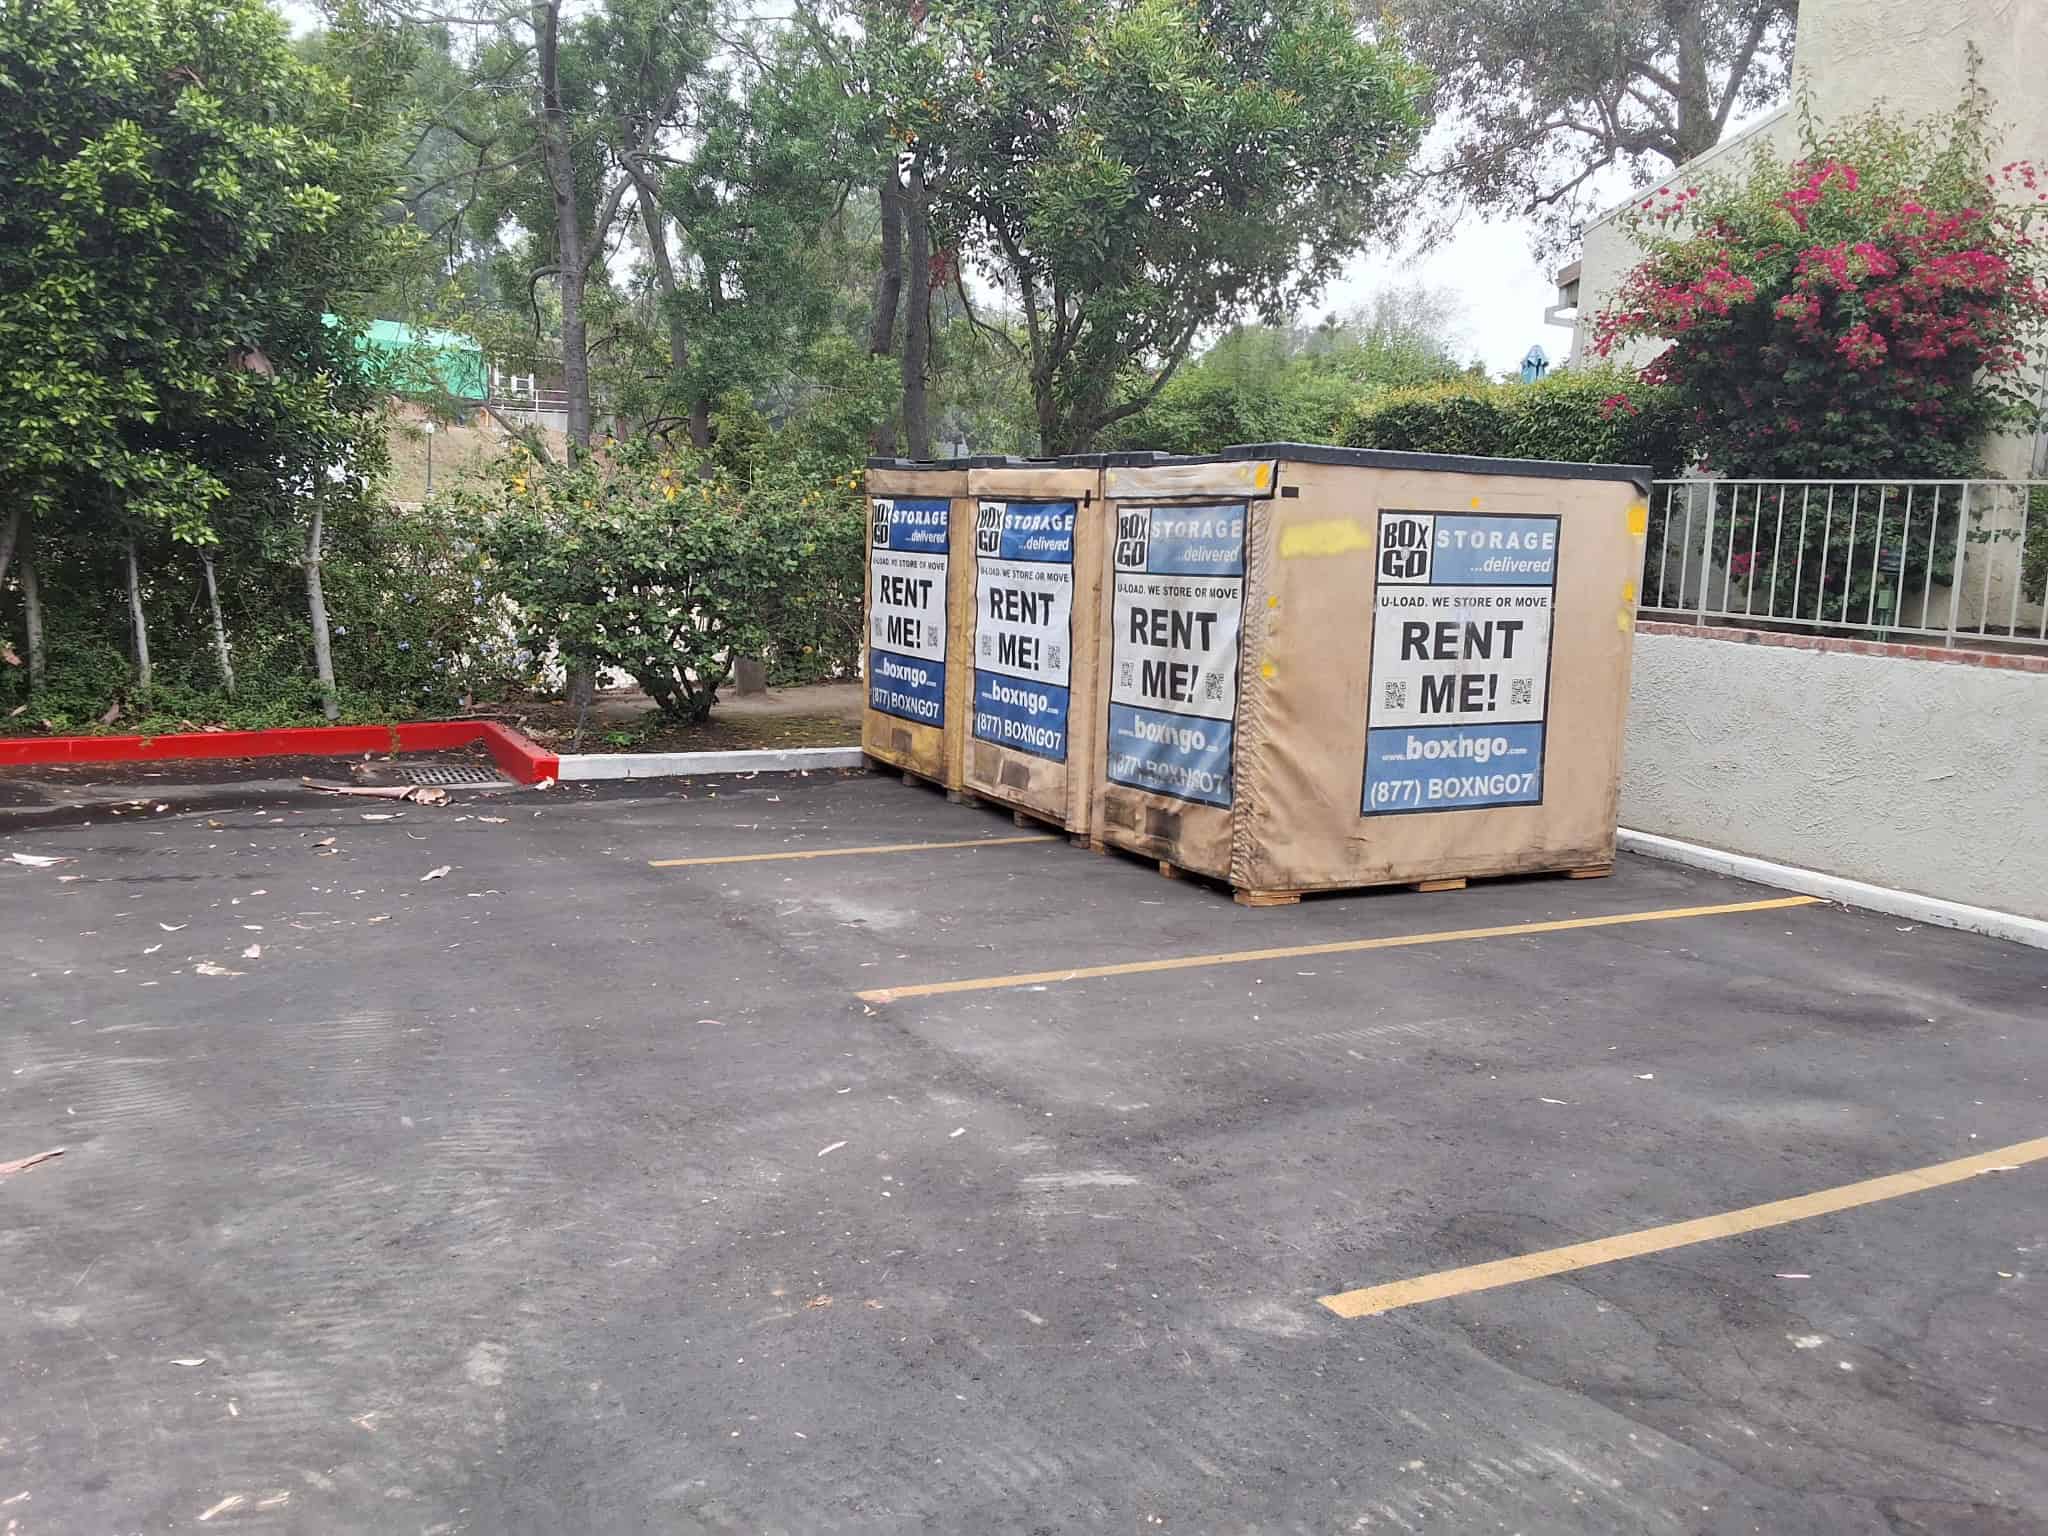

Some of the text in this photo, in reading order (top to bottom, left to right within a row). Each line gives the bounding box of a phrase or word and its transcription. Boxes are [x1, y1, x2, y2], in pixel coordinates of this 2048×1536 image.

[892, 510, 948, 526] STORAGE
[1004, 514, 1074, 531] STORAGE
[1120, 513, 1147, 540] BOX
[1151, 519, 1241, 539] STORAGE
[978, 530, 999, 552] GO
[1384, 519, 1429, 549] BOX
[1437, 530, 1553, 550] STORAGE
[1117, 541, 1145, 568] GO
[1382, 549, 1428, 578] GO
[1470, 556, 1551, 573] ...delivered
[1012, 569, 1033, 580] STORE
[1035, 571, 1045, 581] OR
[1047, 573, 1070, 583] MOVE
[880, 575, 932, 610] RENT
[1117, 583, 1239, 599] U-LOAD. WE STORE OR MOVE
[1381, 596, 1548, 608] U-LOAD. WE STORE OR MOVE
[989, 587, 1054, 626] RENT
[887, 615, 921, 648] ME!
[1130, 606, 1217, 651] RENT
[1401, 620, 1523, 661] RENT
[998, 632, 1040, 671] ME!
[1142, 659, 1199, 703] ME!
[1420, 673, 1499, 713] ME!
[891, 692, 939, 719] BOXNGO7
[977, 712, 1062, 750] (877) BOXNGO7
[1370, 773, 1534, 808] (877) BOXNGO7
